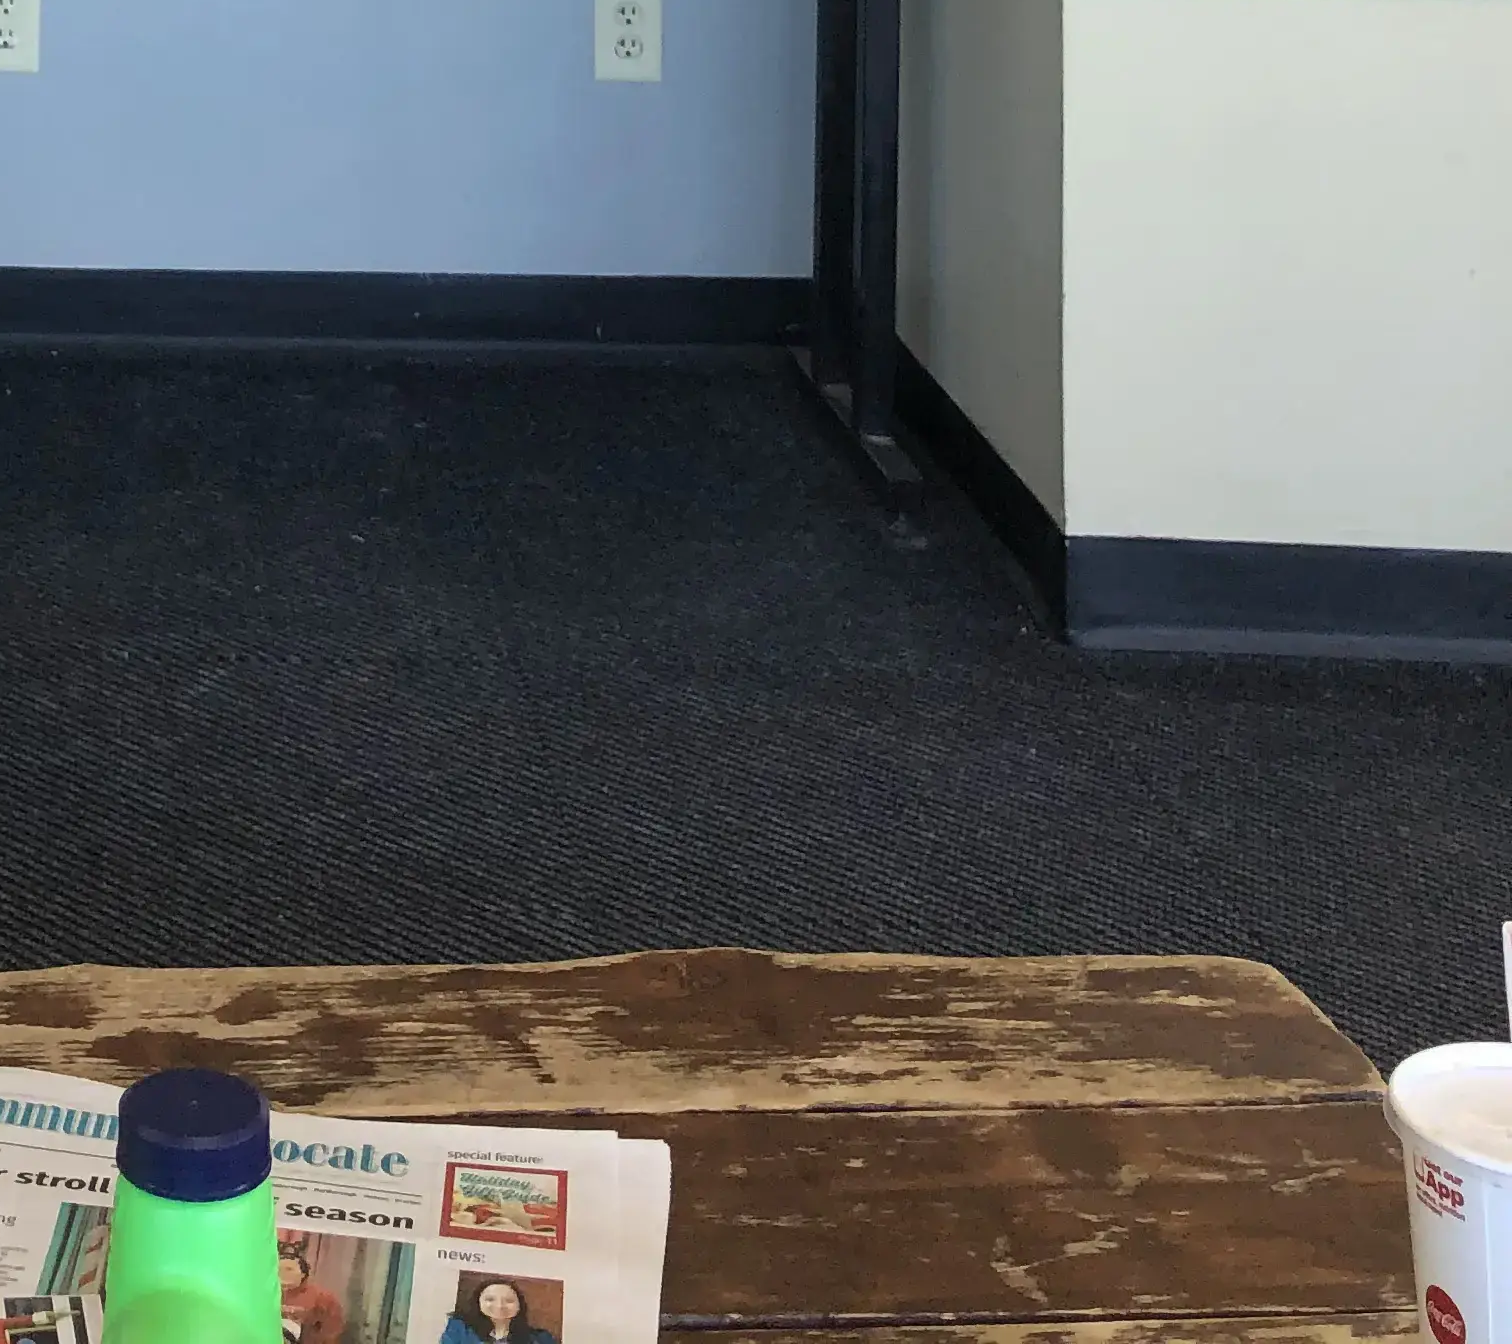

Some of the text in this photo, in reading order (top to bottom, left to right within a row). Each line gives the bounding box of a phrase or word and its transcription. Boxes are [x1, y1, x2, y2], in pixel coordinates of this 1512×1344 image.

[271, 1138, 410, 1178] ocate
[447, 1150, 492, 1163] special
[14, 1170, 111, 1194] stroll
[283, 1202, 414, 1229] season
[1426, 1170, 1465, 1208] App
[438, 1249, 486, 1263] news:
